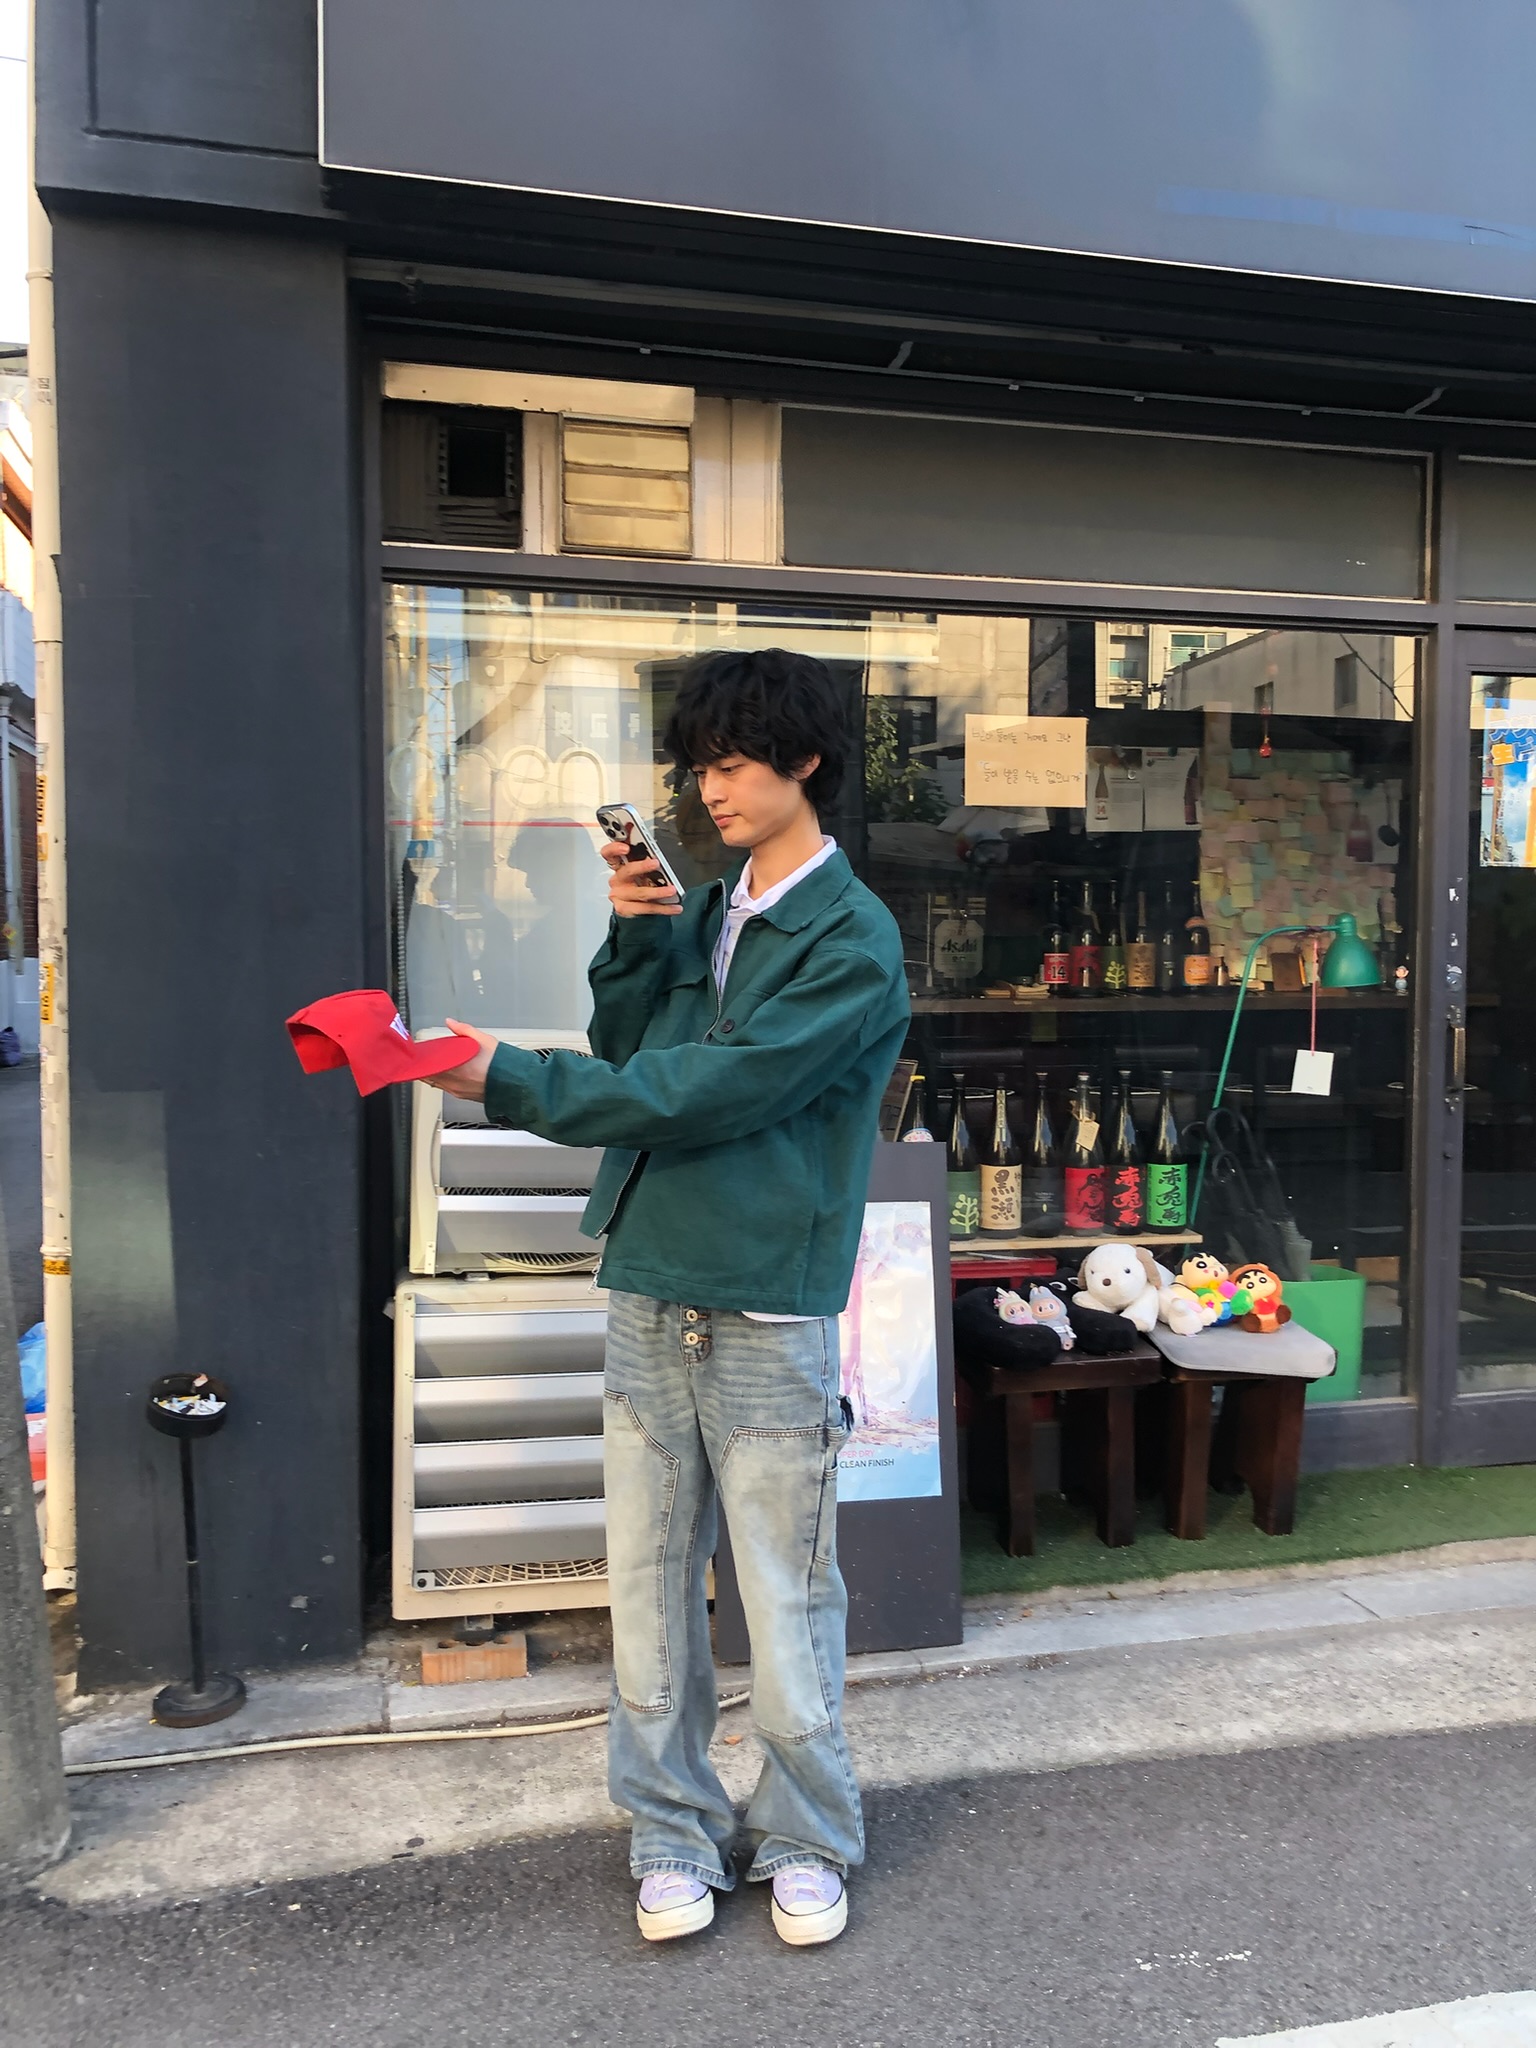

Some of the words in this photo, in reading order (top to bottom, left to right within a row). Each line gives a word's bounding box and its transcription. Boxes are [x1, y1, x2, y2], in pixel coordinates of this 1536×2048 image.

[1050, 965, 1067, 980] 14
[859, 1448, 875, 1457] DRY
[840, 1460, 867, 1469] CLEAN
[868, 1458, 895, 1467] FINISH
